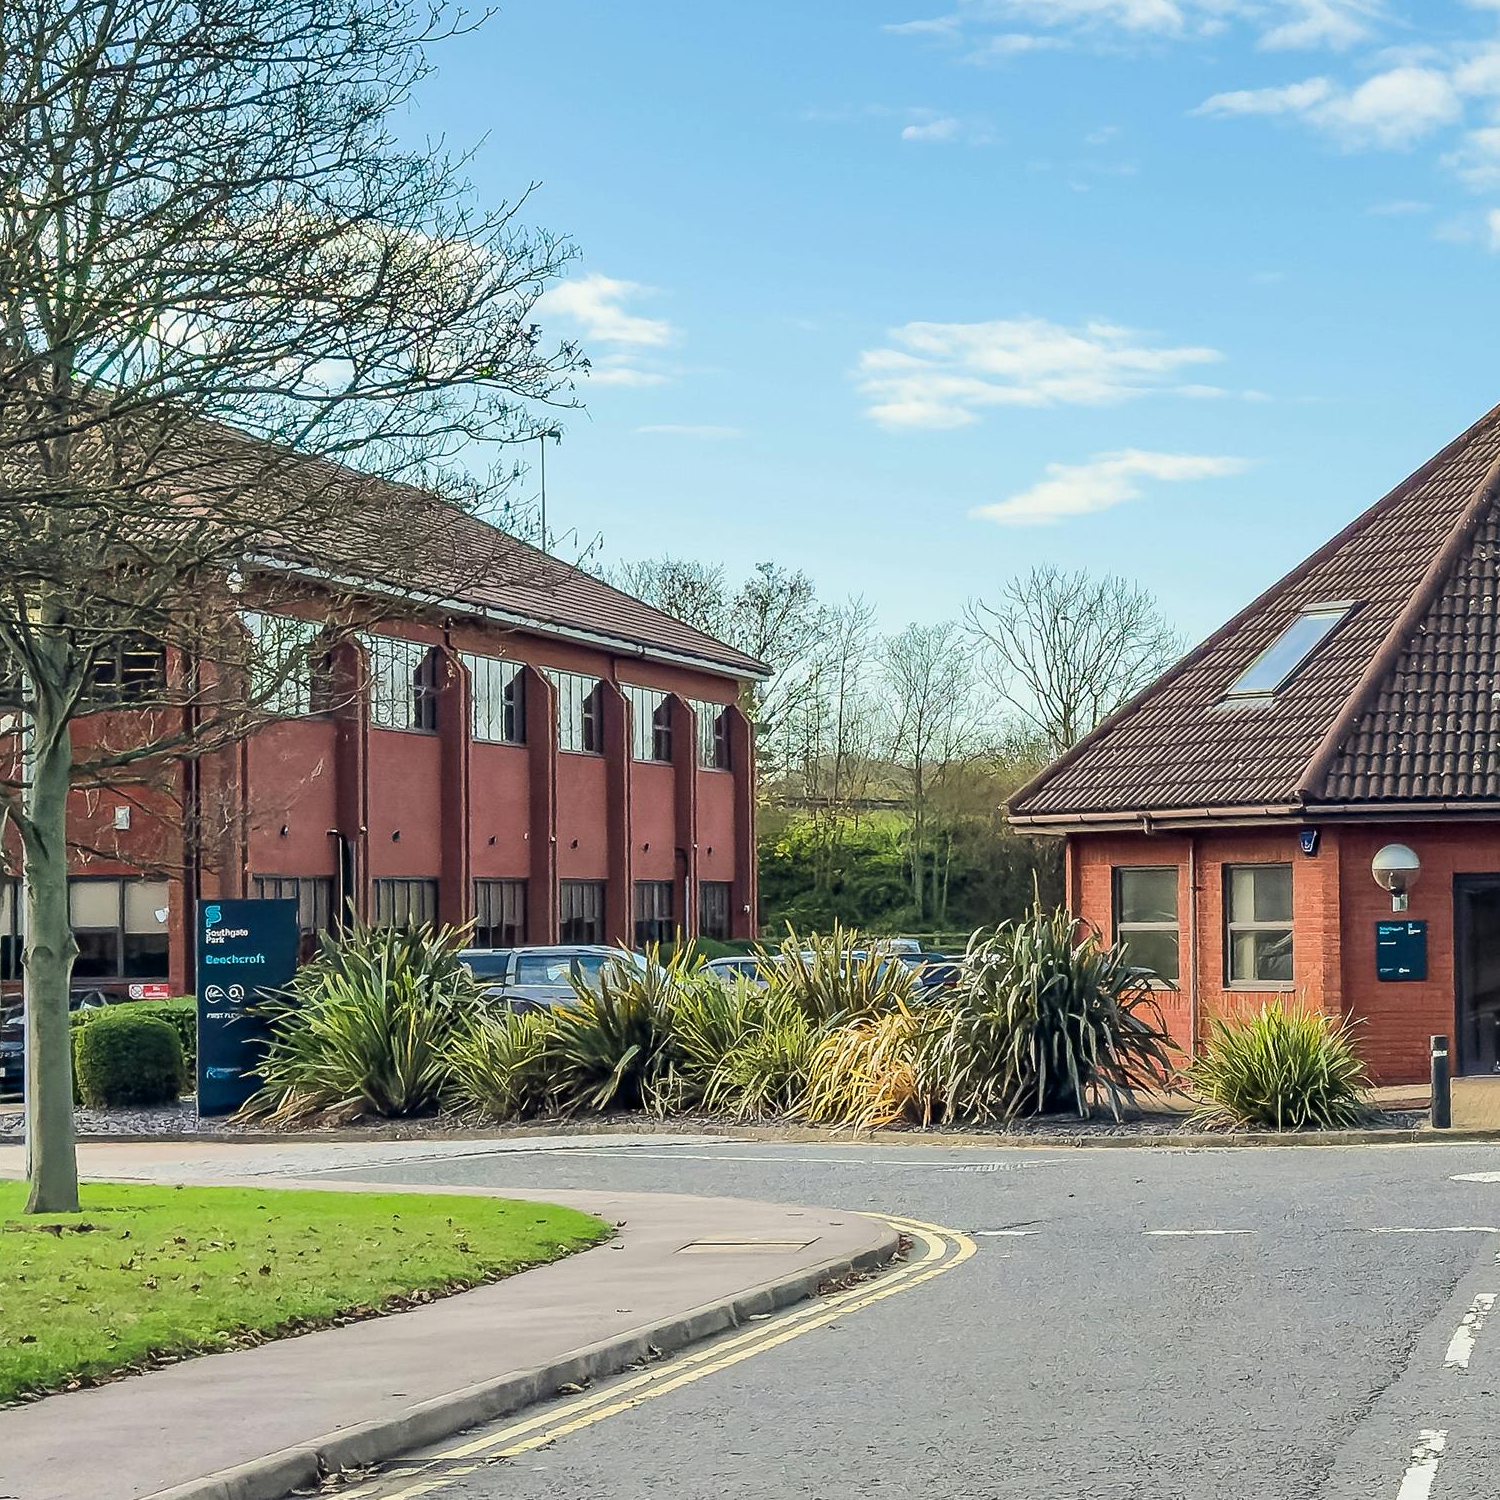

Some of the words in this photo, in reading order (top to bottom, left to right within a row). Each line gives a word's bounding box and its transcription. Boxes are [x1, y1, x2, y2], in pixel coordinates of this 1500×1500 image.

[205, 928, 249, 938] Southgate
[205, 936, 225, 944] Park
[205, 953, 266, 964] Beechcroft
